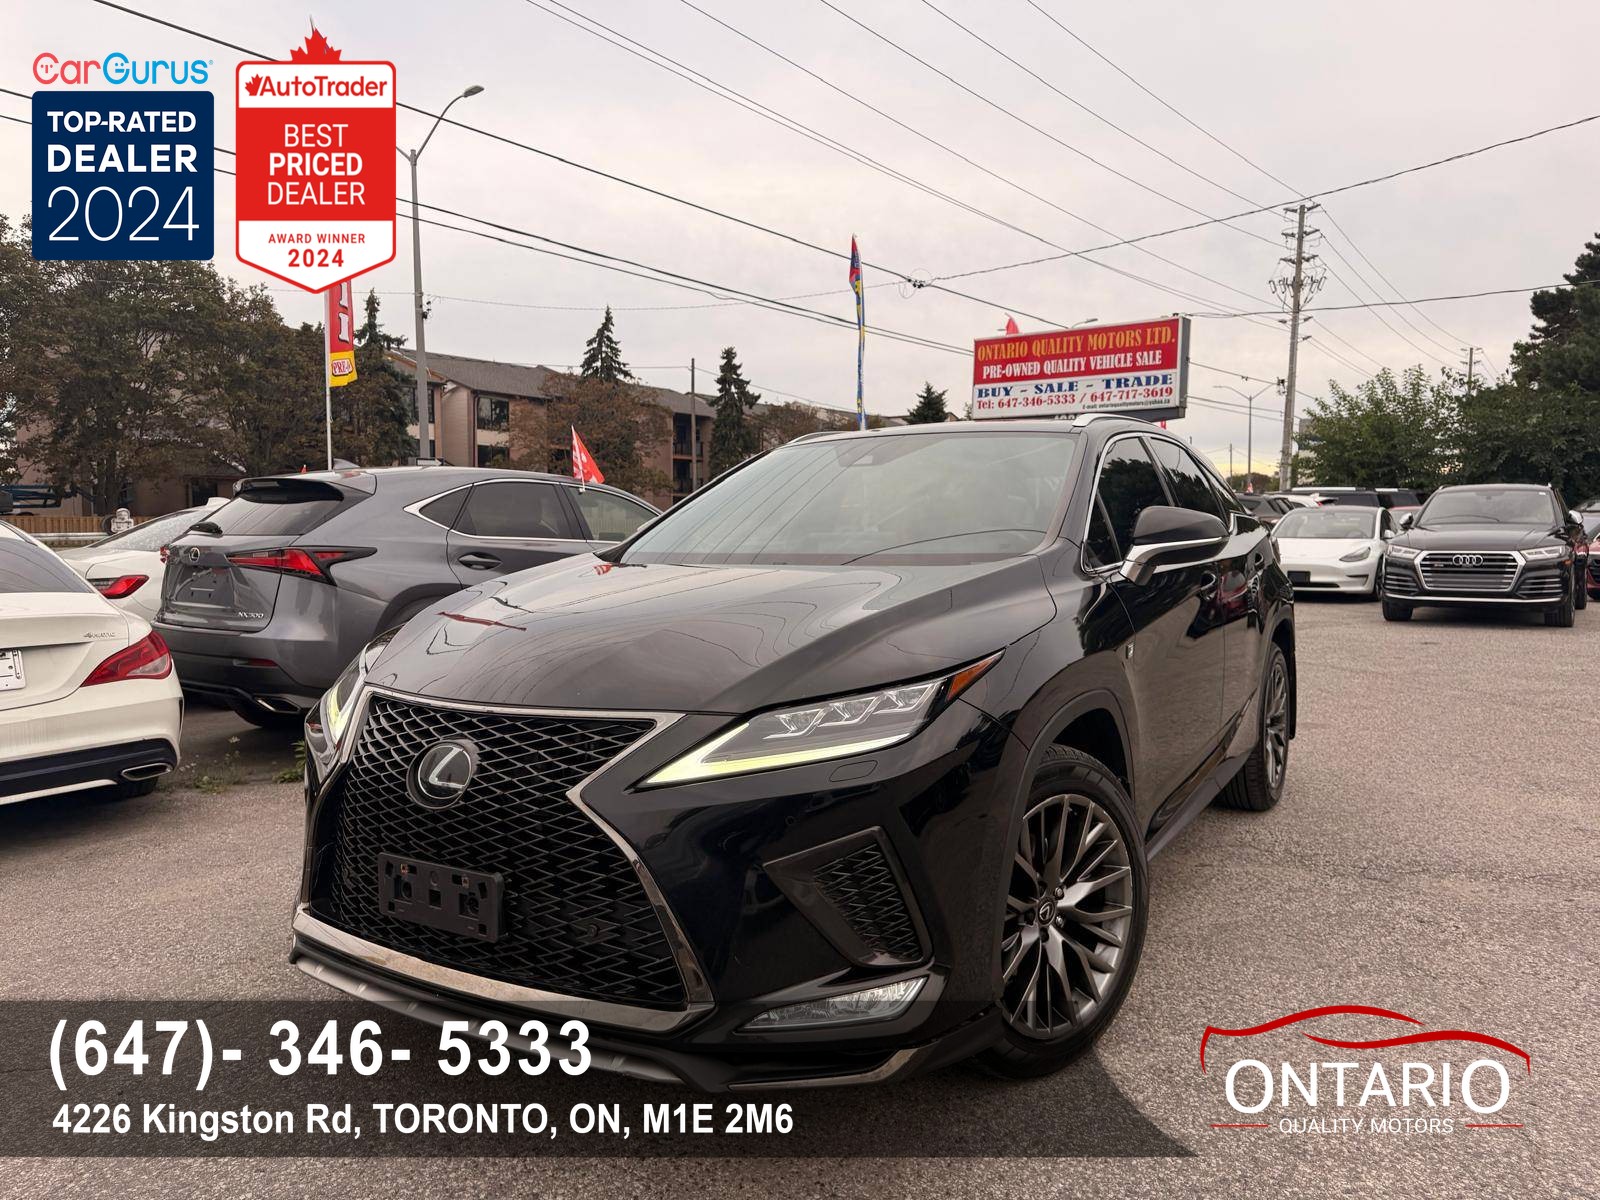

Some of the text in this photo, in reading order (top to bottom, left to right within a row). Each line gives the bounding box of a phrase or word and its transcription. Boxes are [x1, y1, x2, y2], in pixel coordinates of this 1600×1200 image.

[977, 326, 1176, 361] ONTARIO QUALITY MOTORS LTD.
[982, 349, 1162, 379] PRE-OWNED QUALITY VEHICLE SALE
[977, 386, 1013, 398] BUY
[1034, 381, 1079, 394] SALE
[1102, 373, 1173, 389] TRADE
[977, 400, 994, 410] Tel:
[998, 393, 1076, 409] 647-346-5333
[1090, 386, 1174, 403] 647-717-3619
